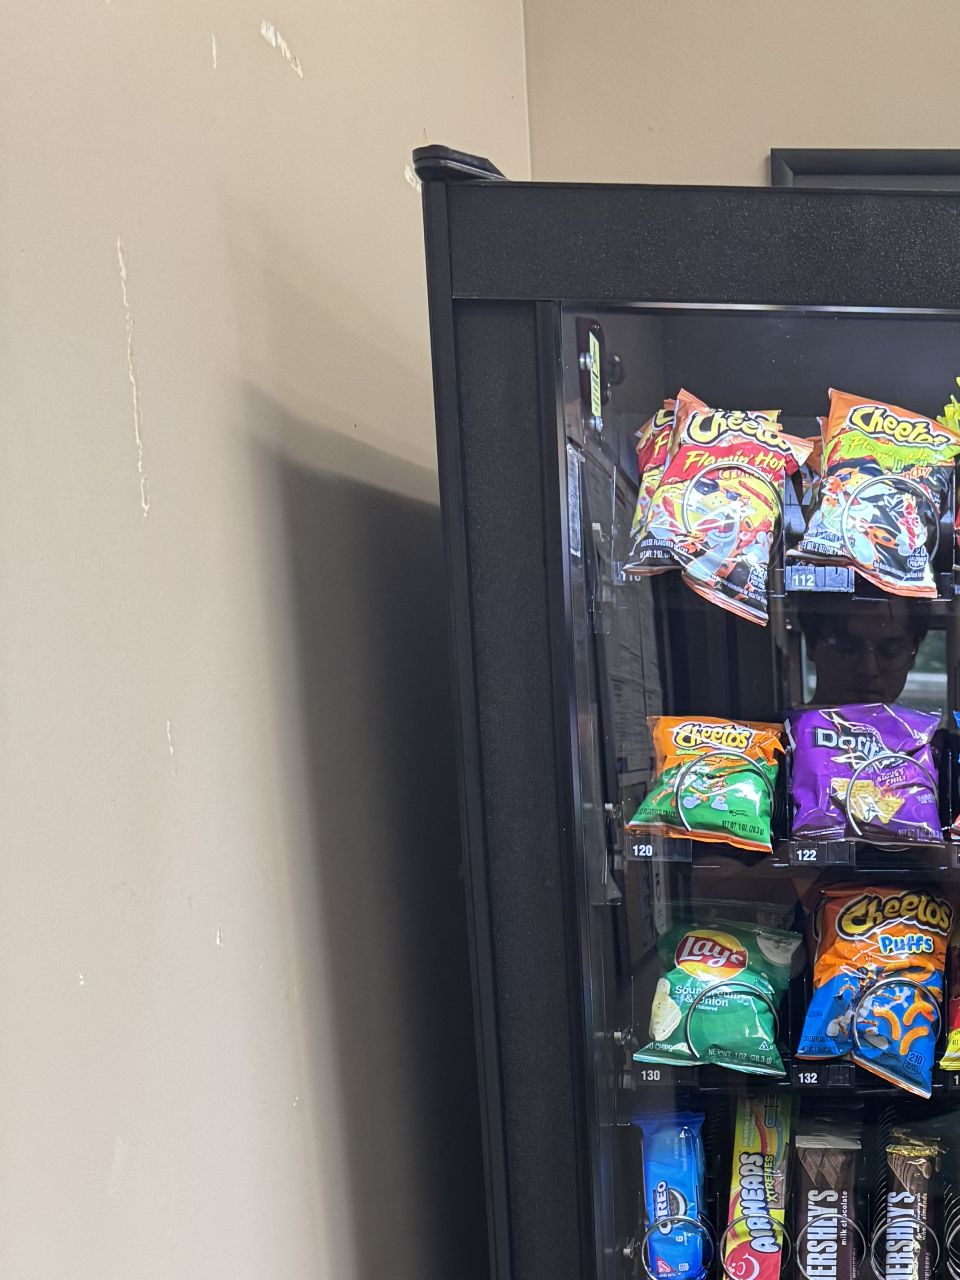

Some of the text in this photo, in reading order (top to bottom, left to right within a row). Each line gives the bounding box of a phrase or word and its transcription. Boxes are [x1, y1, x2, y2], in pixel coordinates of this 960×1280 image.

[851, 406, 950, 446] Cheetos
[755, 451, 786, 471] Hot
[793, 575, 815, 586] 112
[676, 723, 751, 748] Cheetos
[633, 845, 653, 856] 120
[796, 850, 817, 860] 122
[841, 896, 950, 935] Cheetos
[679, 936, 744, 967] Lay's
[879, 935, 933, 953] Puffs
[699, 998, 728, 1007] Onion
[909, 1053, 922, 1065] 210
[641, 1070, 660, 1081] 130
[798, 1073, 818, 1084] 132
[764, 1154, 778, 1203] XTREMES
[655, 1180, 672, 1235] OREO
[739, 1151, 780, 1253] AIRHEADS
